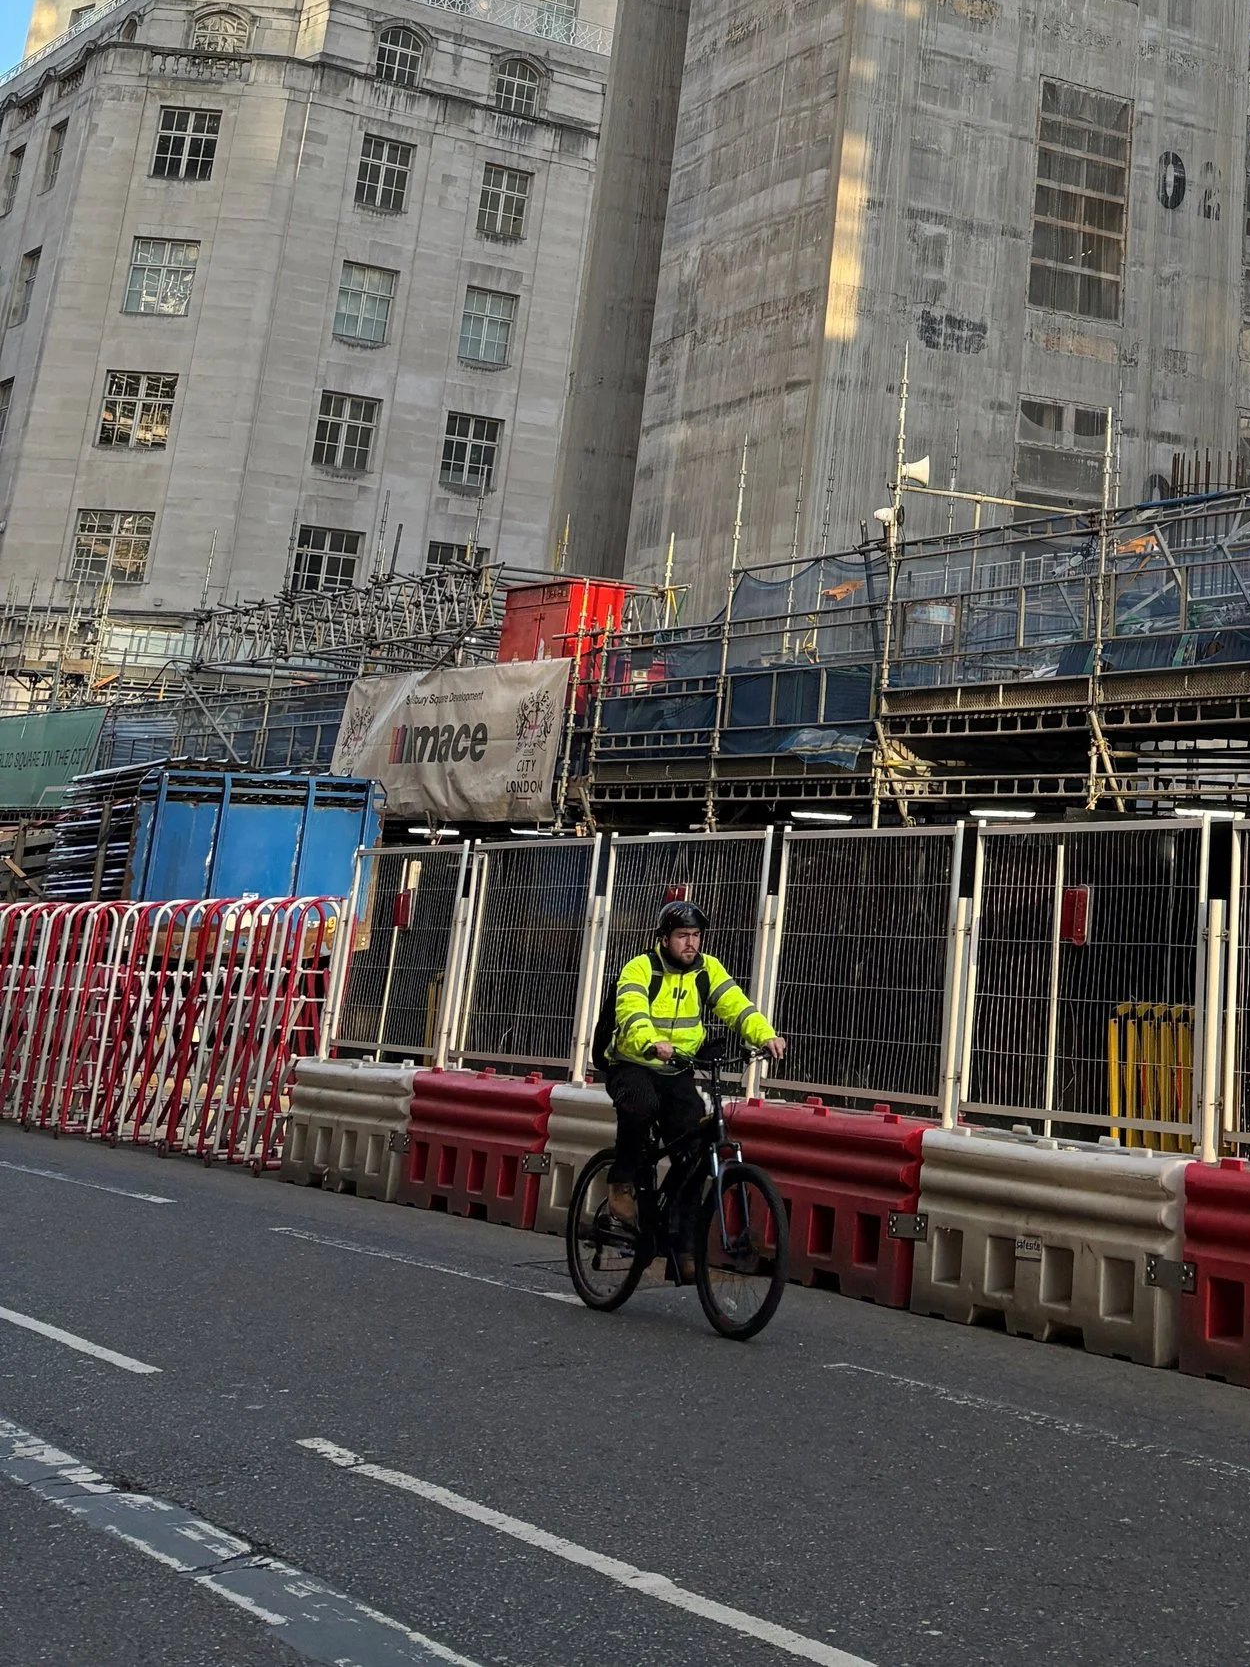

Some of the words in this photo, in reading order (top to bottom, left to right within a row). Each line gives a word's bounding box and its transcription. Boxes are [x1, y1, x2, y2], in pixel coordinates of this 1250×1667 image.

[429, 694, 449, 706] Square
[449, 690, 484, 703] Development
[413, 722, 488, 764] mace
[0, 753, 14, 768] LIC
[42, 750, 54, 766] IN
[55, 749, 70, 766] THE
[516, 760, 536, 772] CITY
[506, 780, 544, 794] LONDON
